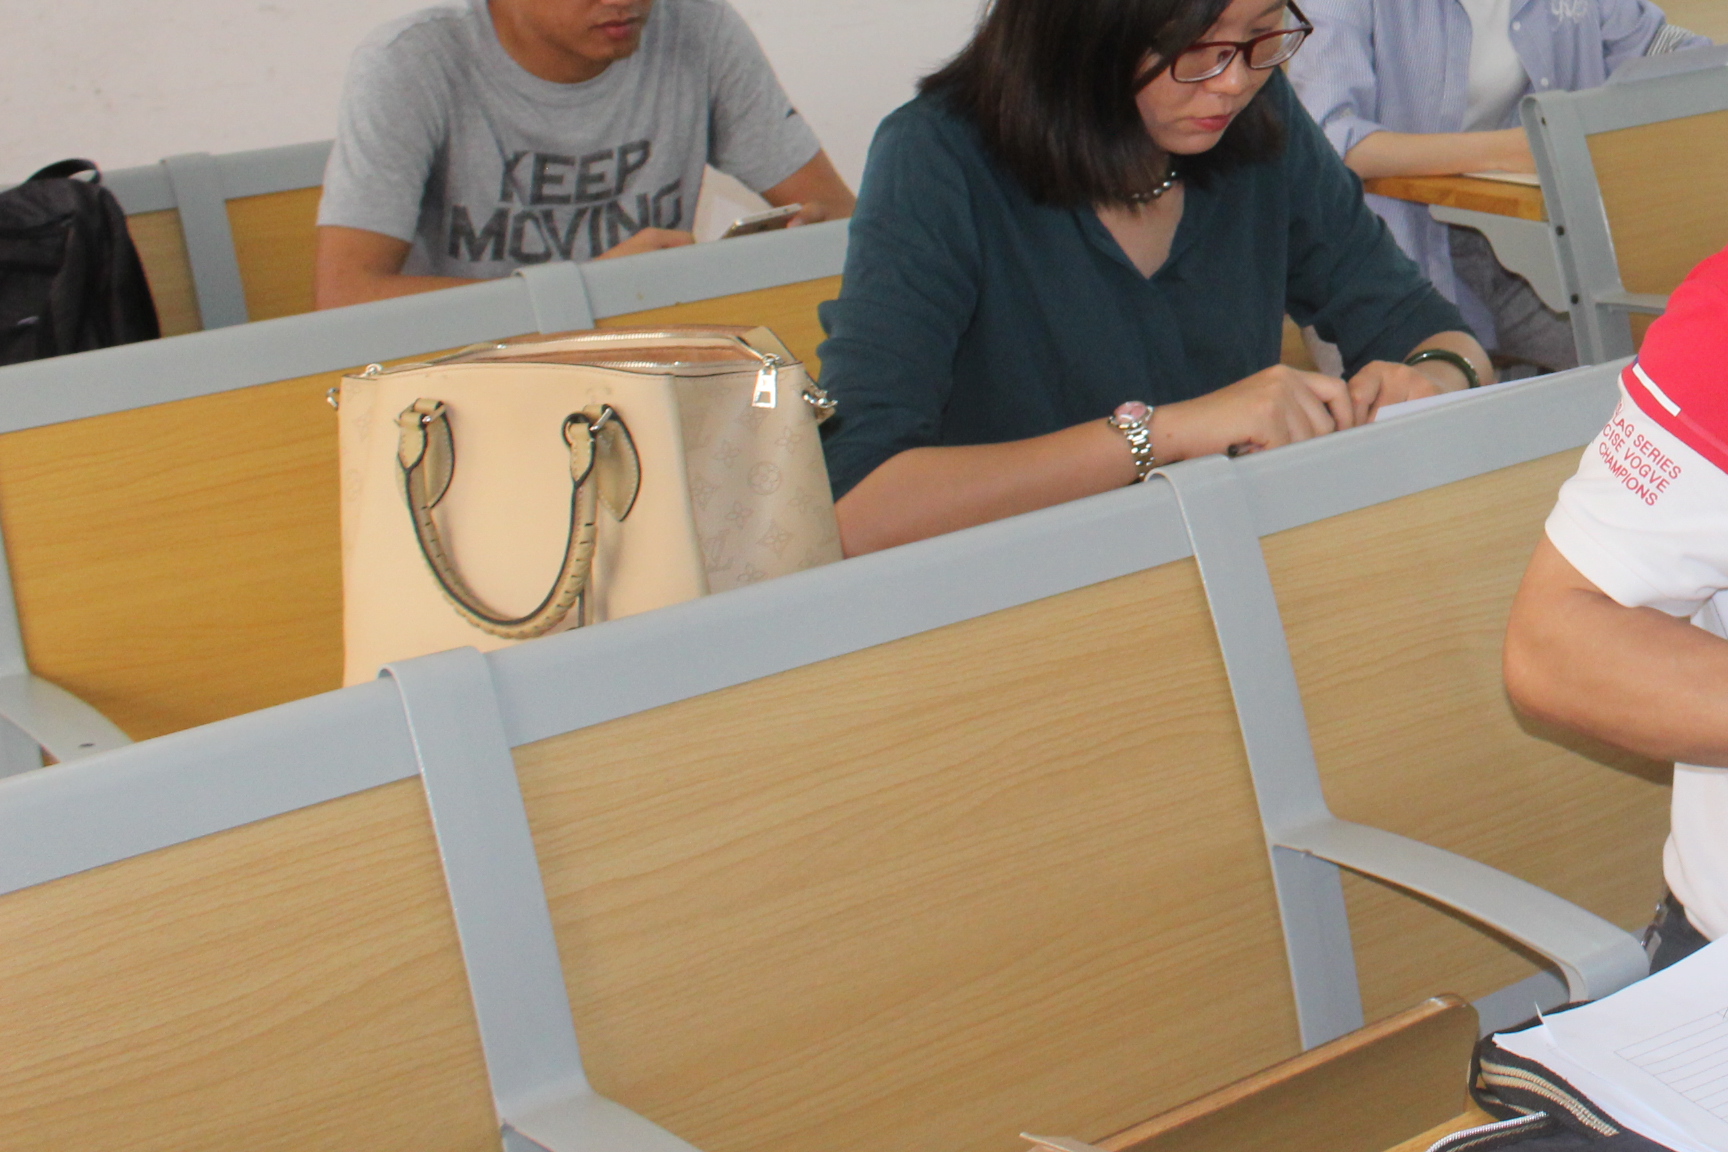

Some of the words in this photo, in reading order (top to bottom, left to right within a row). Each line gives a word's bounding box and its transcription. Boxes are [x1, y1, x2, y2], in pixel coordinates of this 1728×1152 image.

[500, 140, 652, 205] KEEP
[449, 177, 684, 264] MOVING
[1598, 441, 1659, 507] CHAMPIONS
[1602, 423, 1626, 453] CISE
[1624, 447, 1671, 494] VOGVE
[1633, 433, 1682, 480] SERIES
